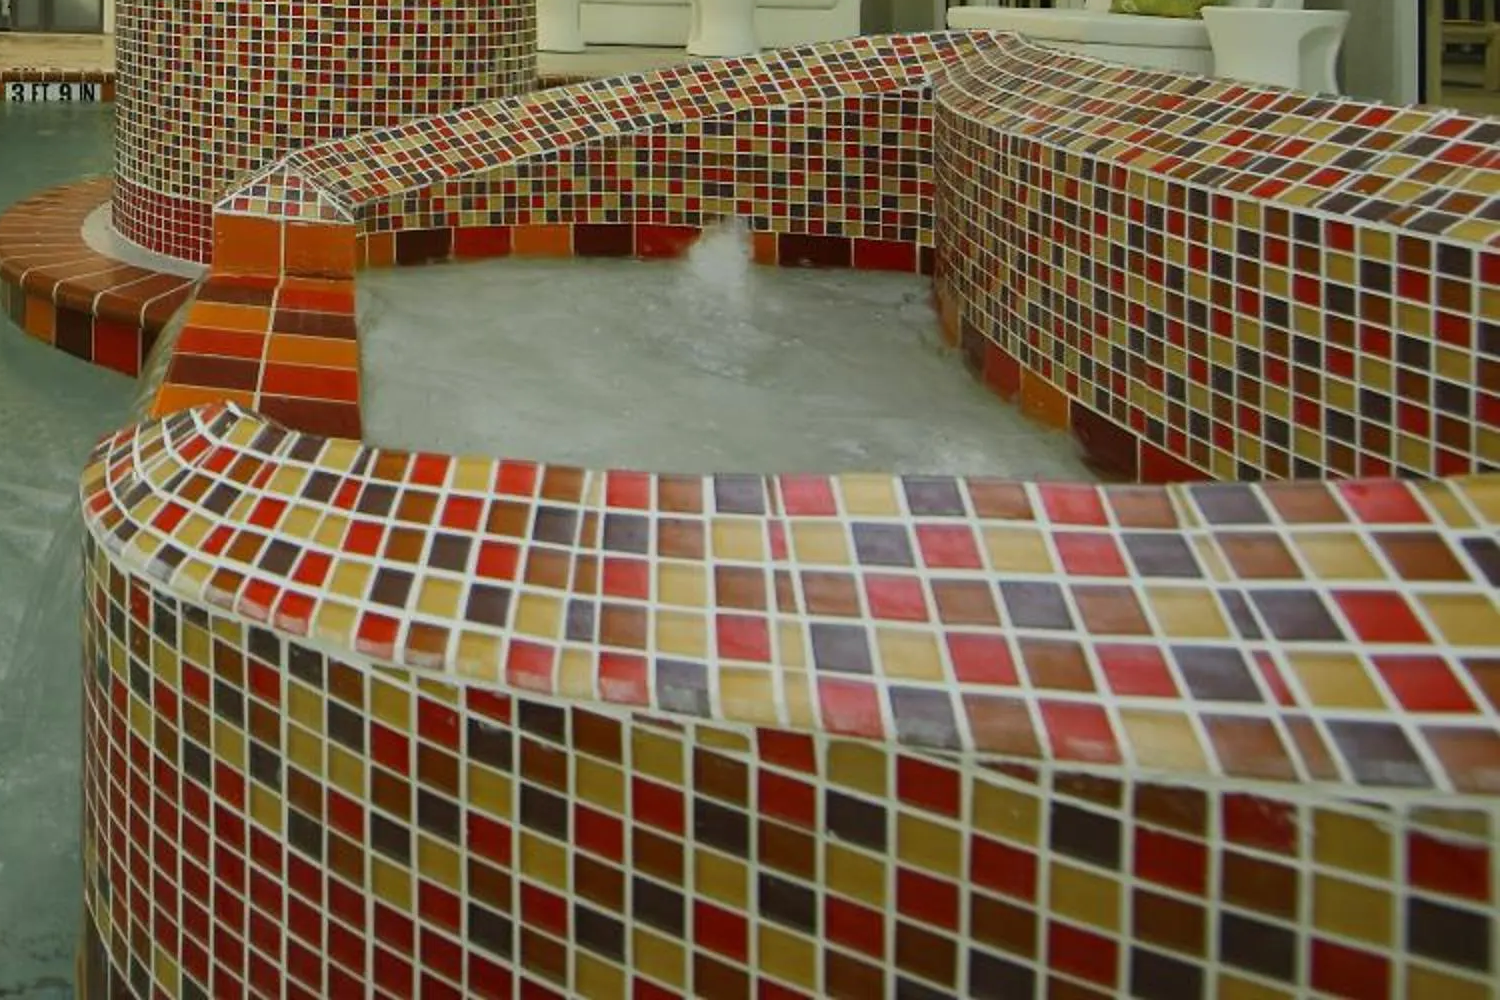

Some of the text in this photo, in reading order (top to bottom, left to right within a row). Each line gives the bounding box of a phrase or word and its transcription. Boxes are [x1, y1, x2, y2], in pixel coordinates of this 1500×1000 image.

[11, 83, 95, 103] 3 FT 9 IN
